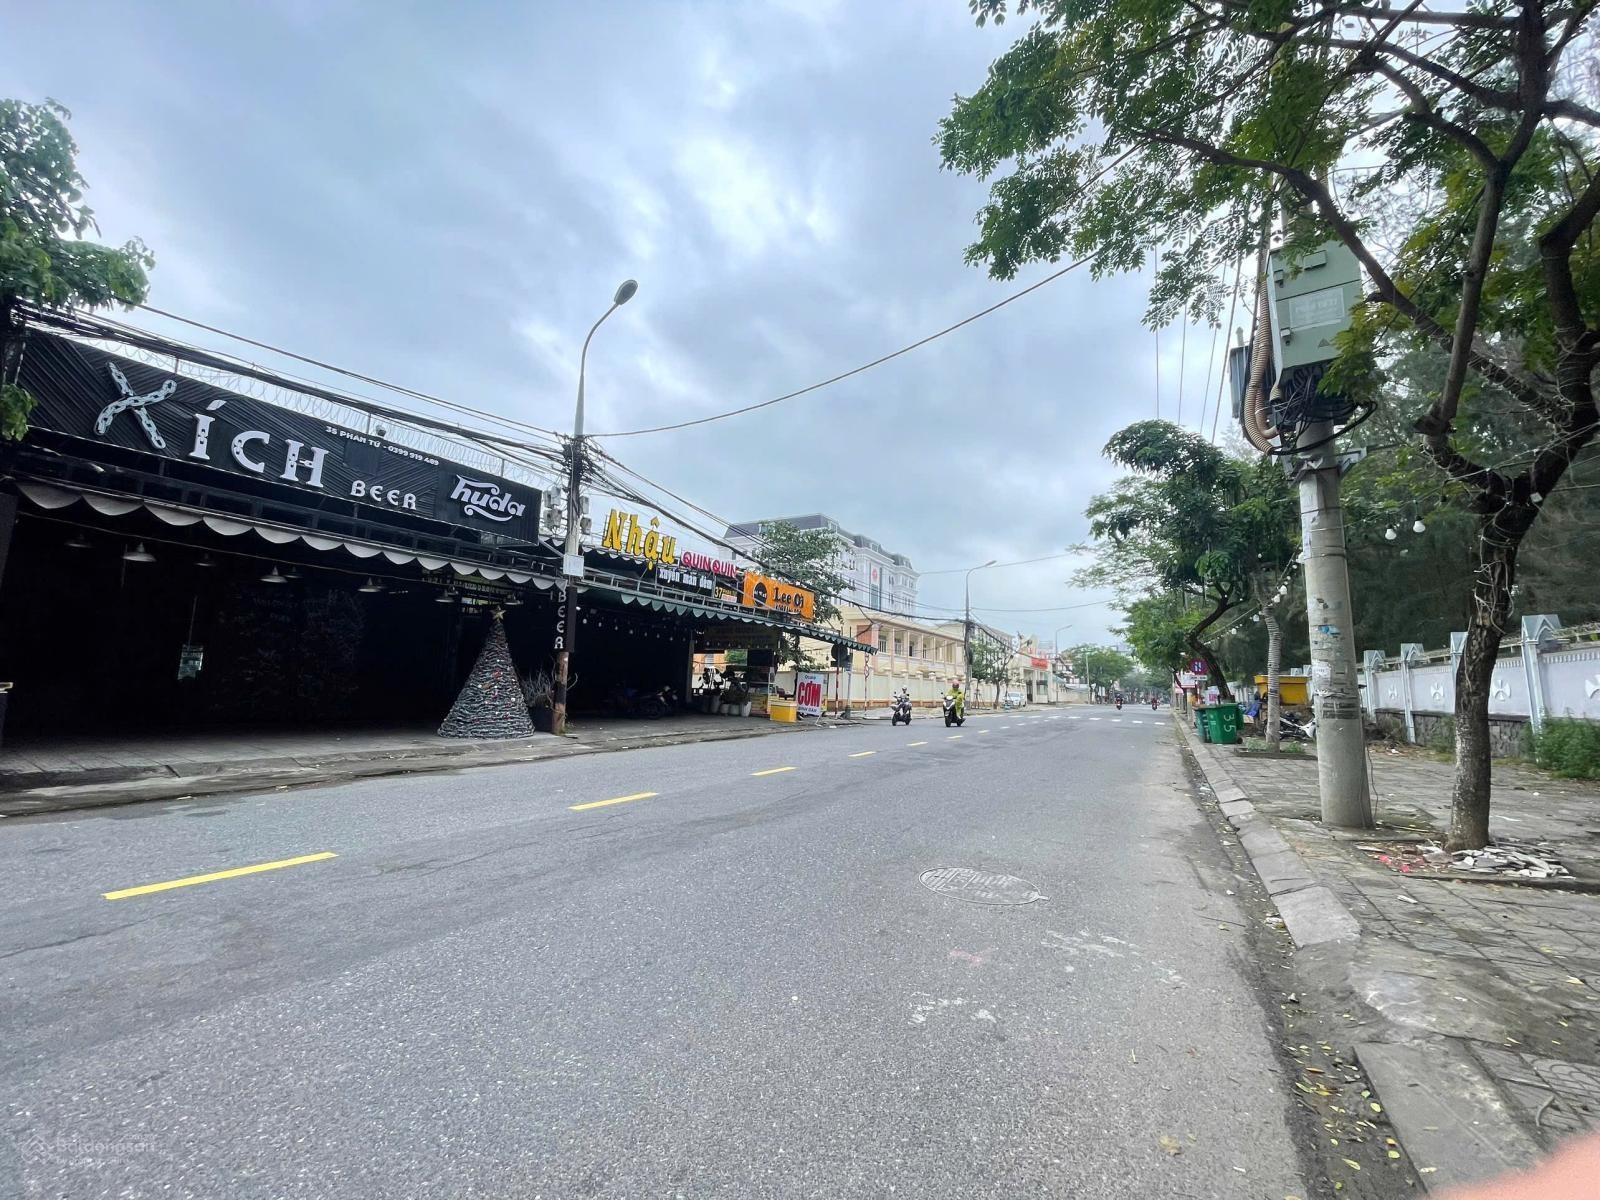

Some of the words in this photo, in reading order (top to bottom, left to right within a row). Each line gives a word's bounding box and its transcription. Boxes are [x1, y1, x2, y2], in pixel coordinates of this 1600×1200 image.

[94, 362, 330, 488] XÍCH
[350, 480, 416, 510] BEER
[602, 508, 678, 571] Nhậu
[714, 586, 723, 599] 37
[773, 587, 792, 605] Lee
[554, 591, 568, 649] BEER
[797, 680, 822, 708] CƠM
[1223, 712, 1238, 734] 35
